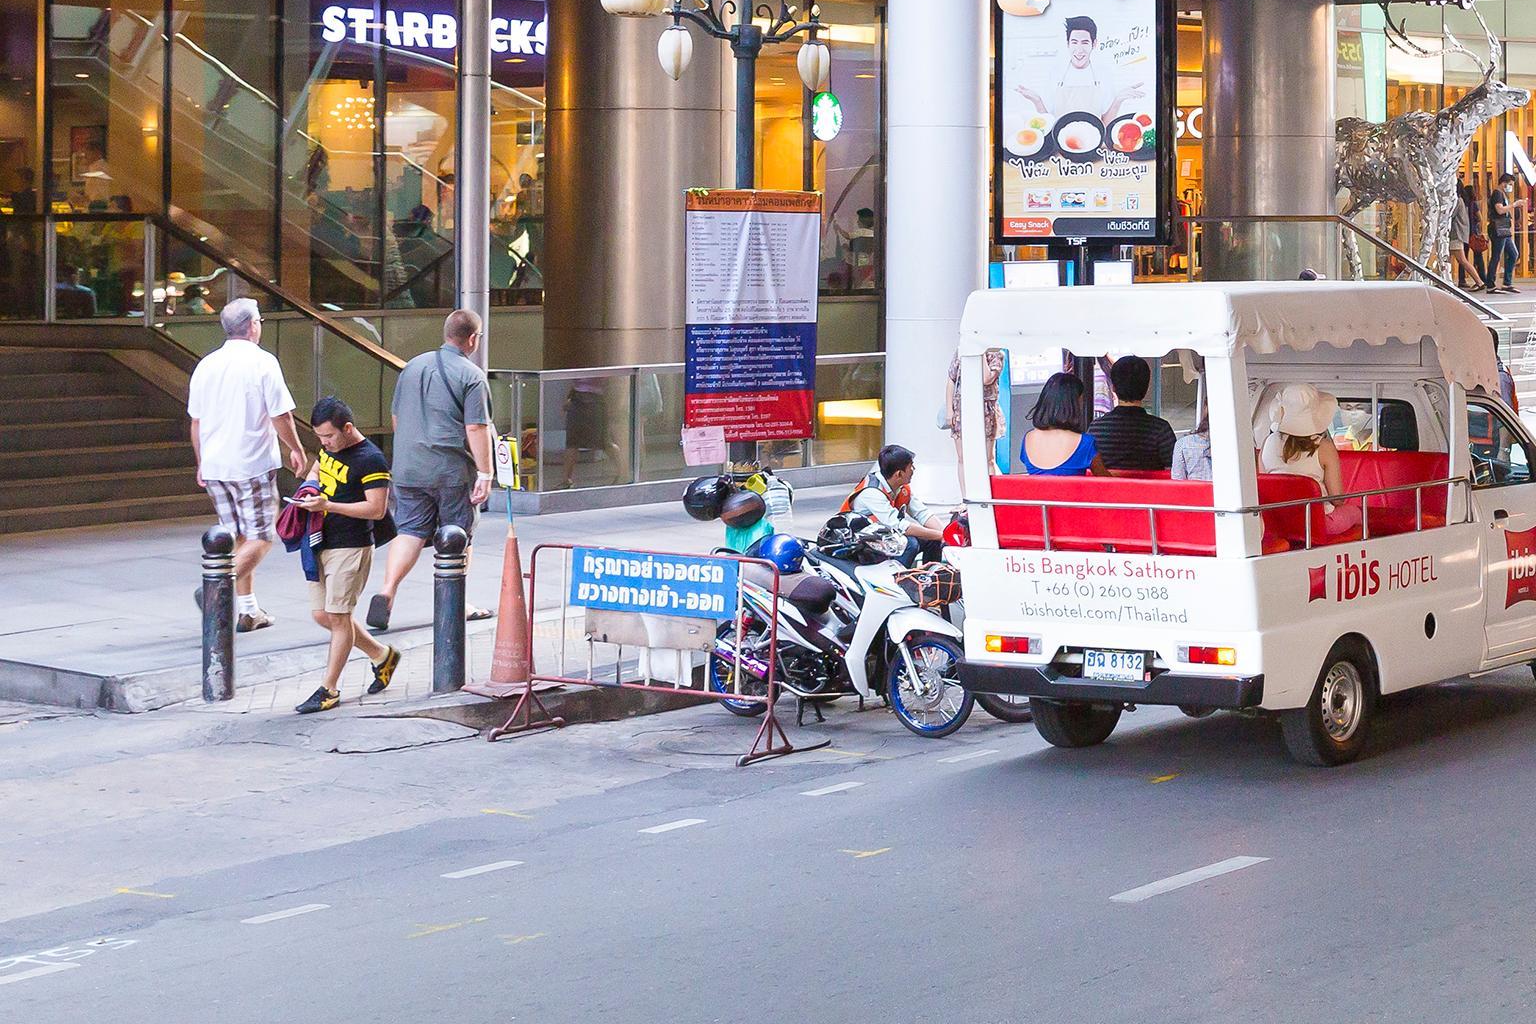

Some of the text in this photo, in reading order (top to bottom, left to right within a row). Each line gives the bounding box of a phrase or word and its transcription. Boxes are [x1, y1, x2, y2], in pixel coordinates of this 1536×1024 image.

[322, 5, 548, 55] STARBCKS
[1010, 155, 1093, 179] ไข่ต้ม ไข่ลวก
[1100, 164, 1149, 182] ยางมะตูม
[1009, 221, 1049, 230] Easy Snack
[1066, 236, 1088, 246] TSF
[583, 552, 724, 584] กรุณาอย่าจอดรถ
[1005, 557, 1196, 581] ibis Bangkok Sathorn
[1336, 549, 1439, 603] ibis HOTEL
[577, 582, 725, 613] ขวางทางเข้า-ออก
[1031, 580, 1041, 595] T
[1046, 581, 1070, 596] +66
[1099, 586, 1132, 599] 2610
[1136, 586, 1169, 601] 5188
[1021, 601, 1189, 624] ibishotel.com/Thailand
[1110, 653, 1143, 671] 8132
